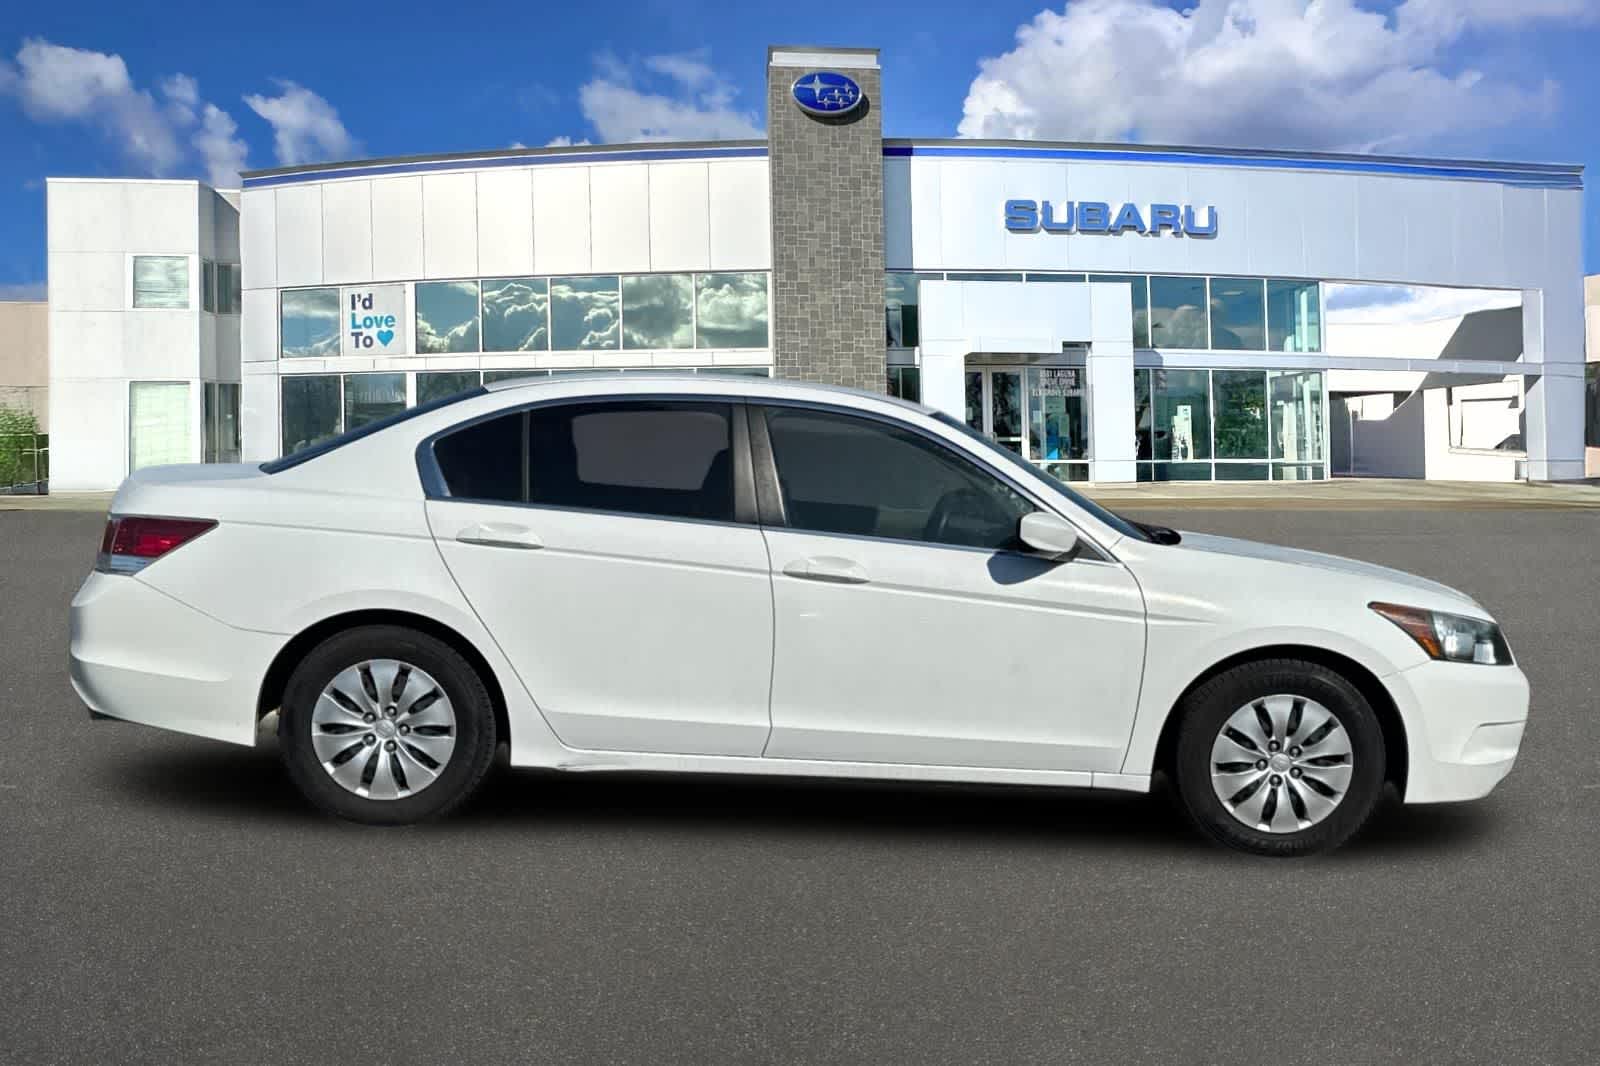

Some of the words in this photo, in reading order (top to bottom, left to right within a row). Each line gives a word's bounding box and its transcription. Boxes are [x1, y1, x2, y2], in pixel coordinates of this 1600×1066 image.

[1005, 199, 1218, 239] SUBARU
[351, 293, 373, 310] I'd
[351, 312, 396, 330] Love
[351, 331, 374, 349] To
